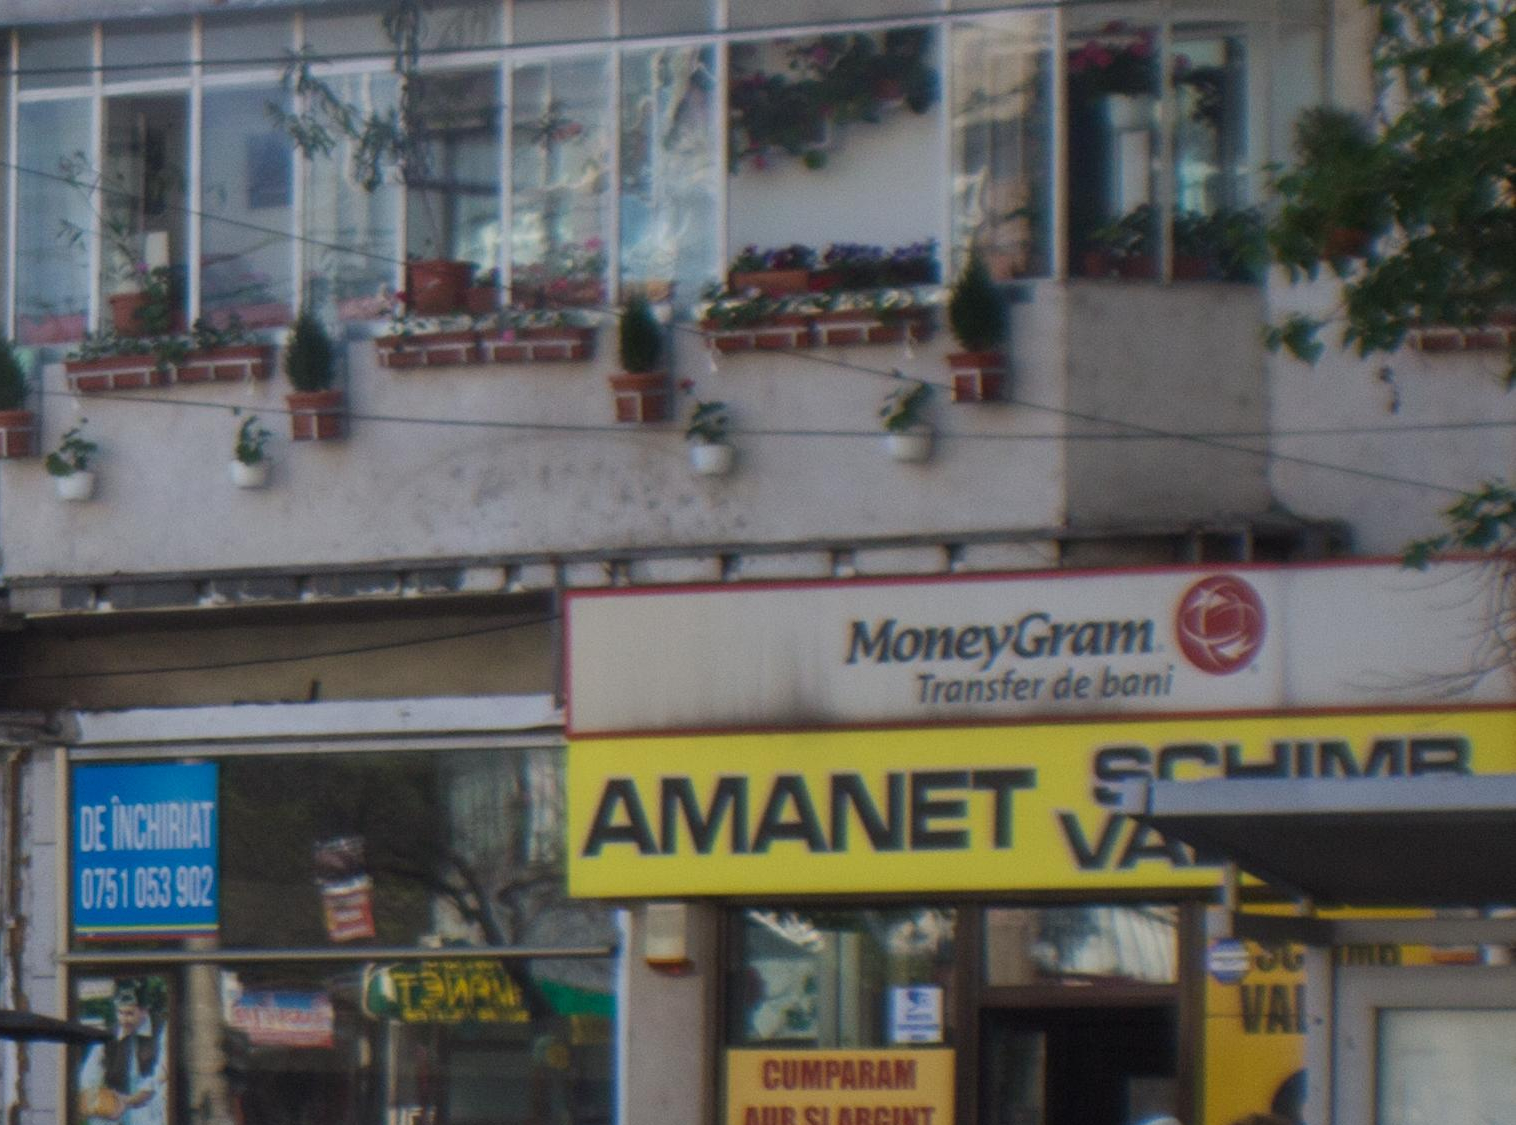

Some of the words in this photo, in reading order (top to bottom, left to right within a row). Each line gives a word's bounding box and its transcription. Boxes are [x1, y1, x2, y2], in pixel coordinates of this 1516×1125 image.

[847, 611, 1155, 671] MoneyGram
[917, 668, 1046, 704] Transfer
[1053, 667, 1091, 700] de
[1102, 665, 1174, 699] bani
[80, 805, 107, 852] DE
[582, 767, 1037, 857] AMANET
[81, 867, 128, 910] 0751
[134, 866, 171, 909] 053
[175, 865, 214, 908] 902
[762, 1058, 916, 1091] CUMPARAM
